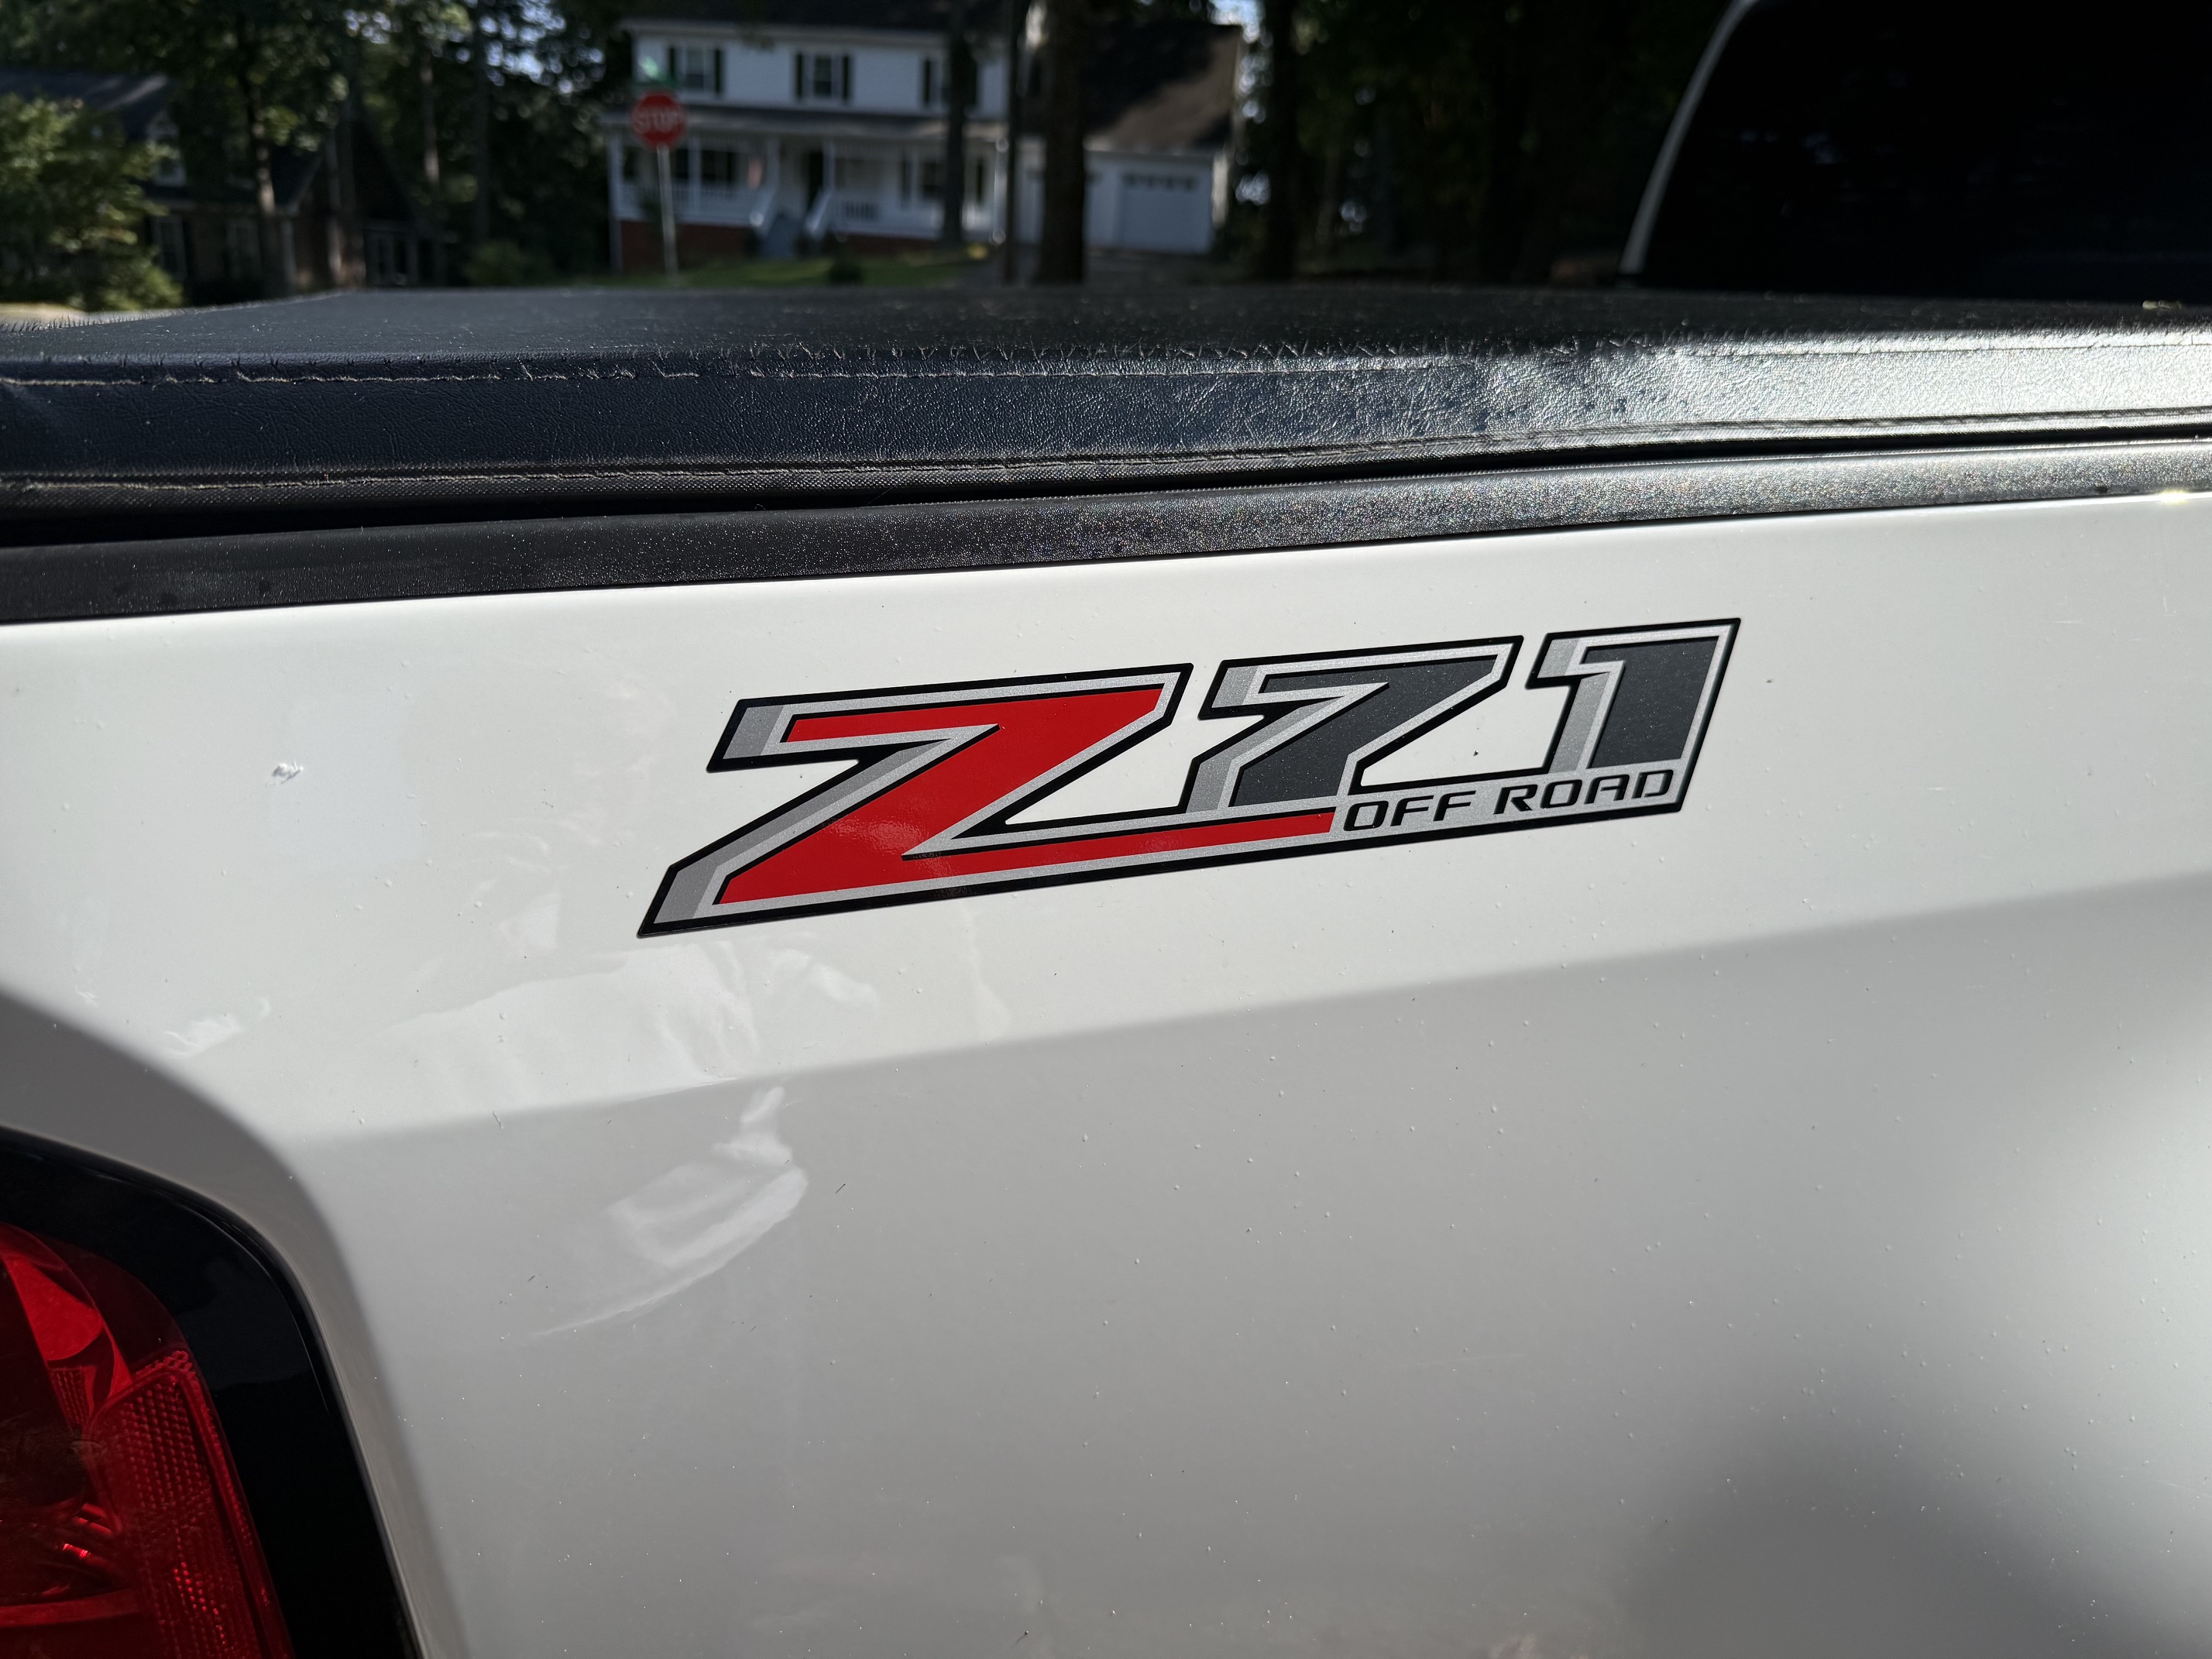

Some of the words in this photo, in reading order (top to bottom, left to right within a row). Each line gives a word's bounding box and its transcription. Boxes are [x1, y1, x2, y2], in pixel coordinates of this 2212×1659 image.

[637, 617, 1741, 939] Z71
[1343, 790, 1477, 833] OFF
[1492, 769, 1674, 816] ROAD
